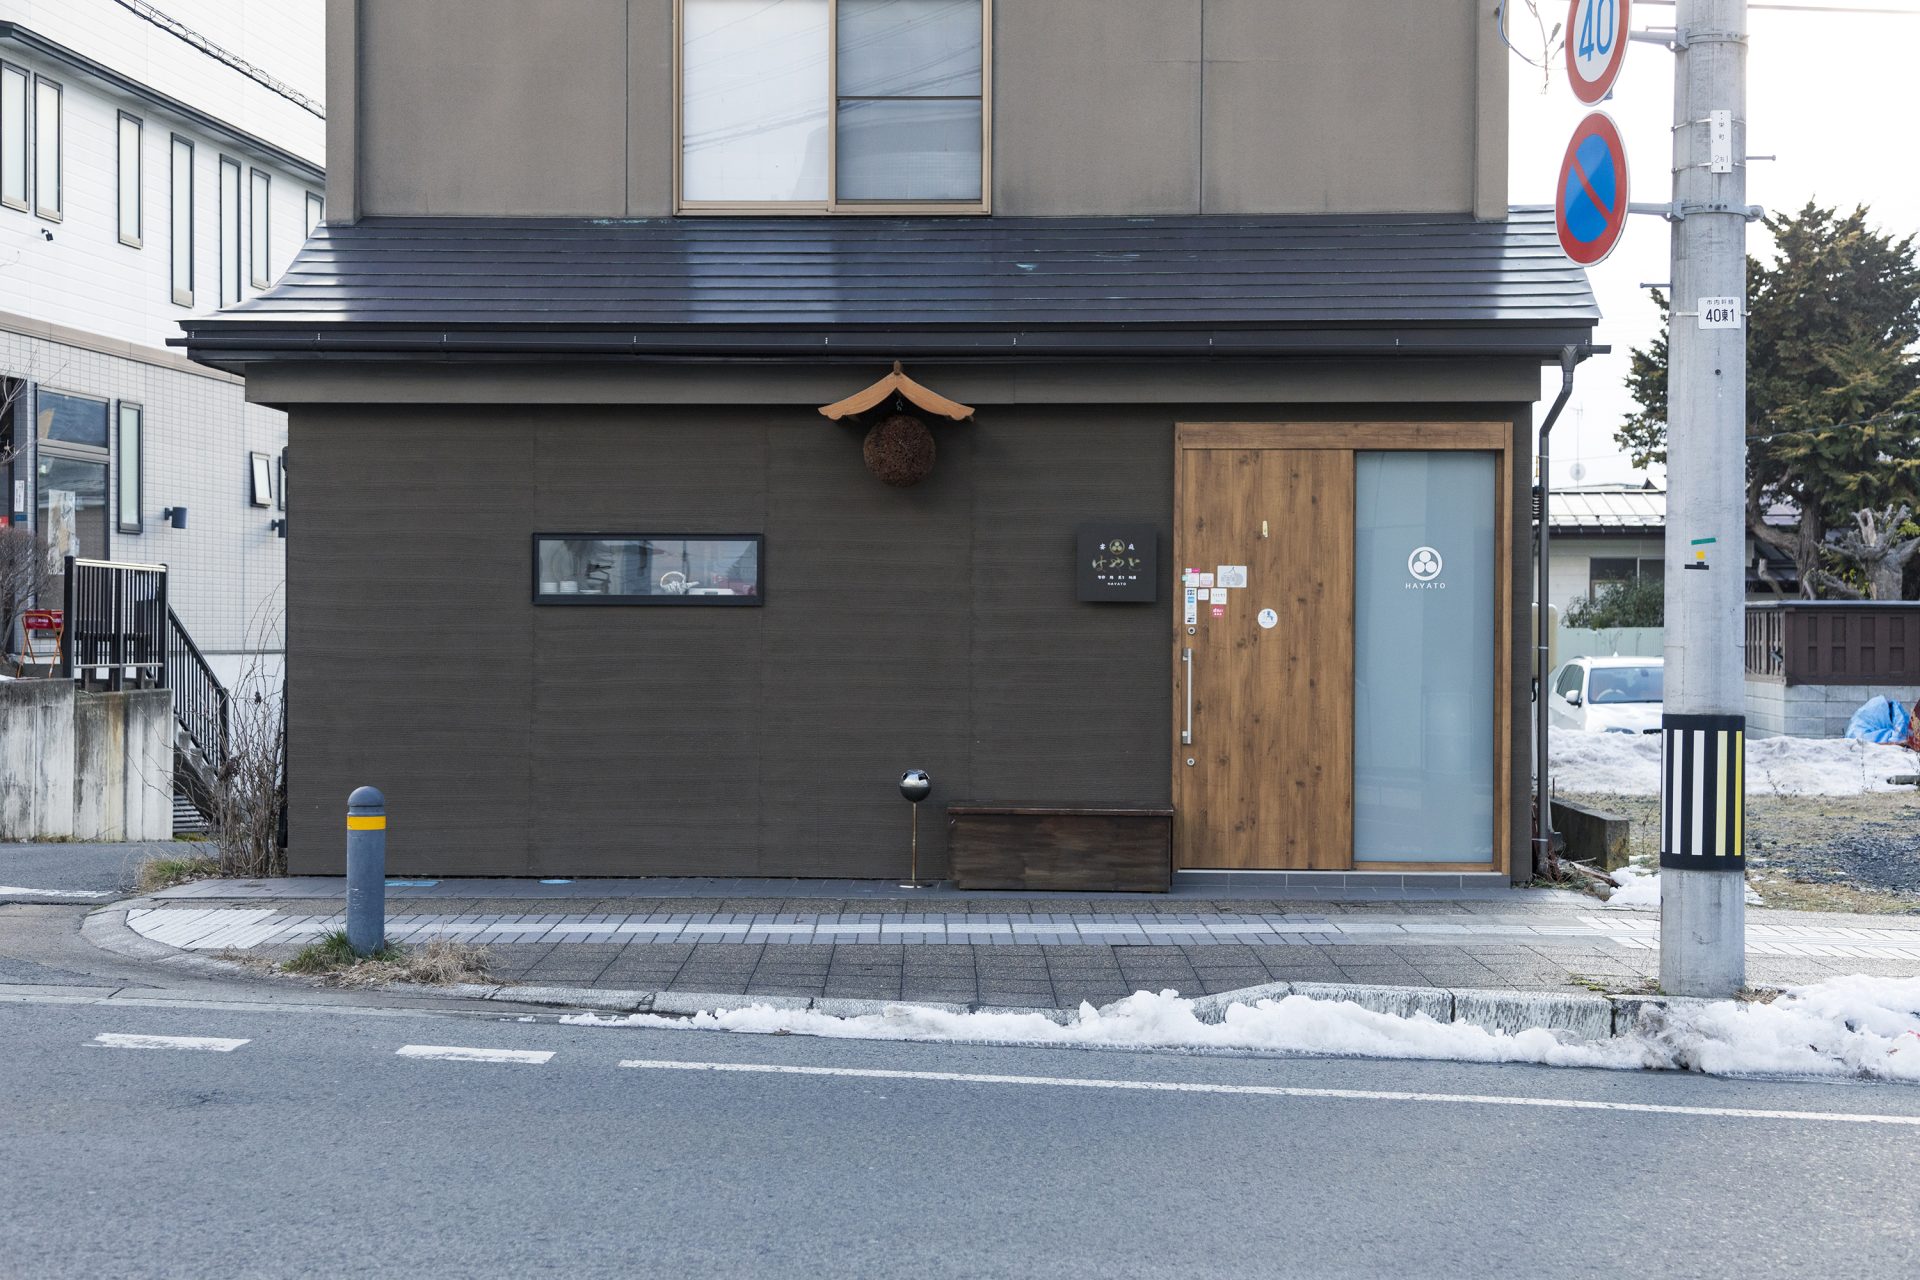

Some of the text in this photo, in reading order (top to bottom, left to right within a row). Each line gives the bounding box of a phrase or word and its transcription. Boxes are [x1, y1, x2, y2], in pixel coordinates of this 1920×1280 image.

[1578, 0, 1614, 62] 40
[1706, 308, 1735, 323] 40東1
[1092, 554, 1142, 573] はやと
